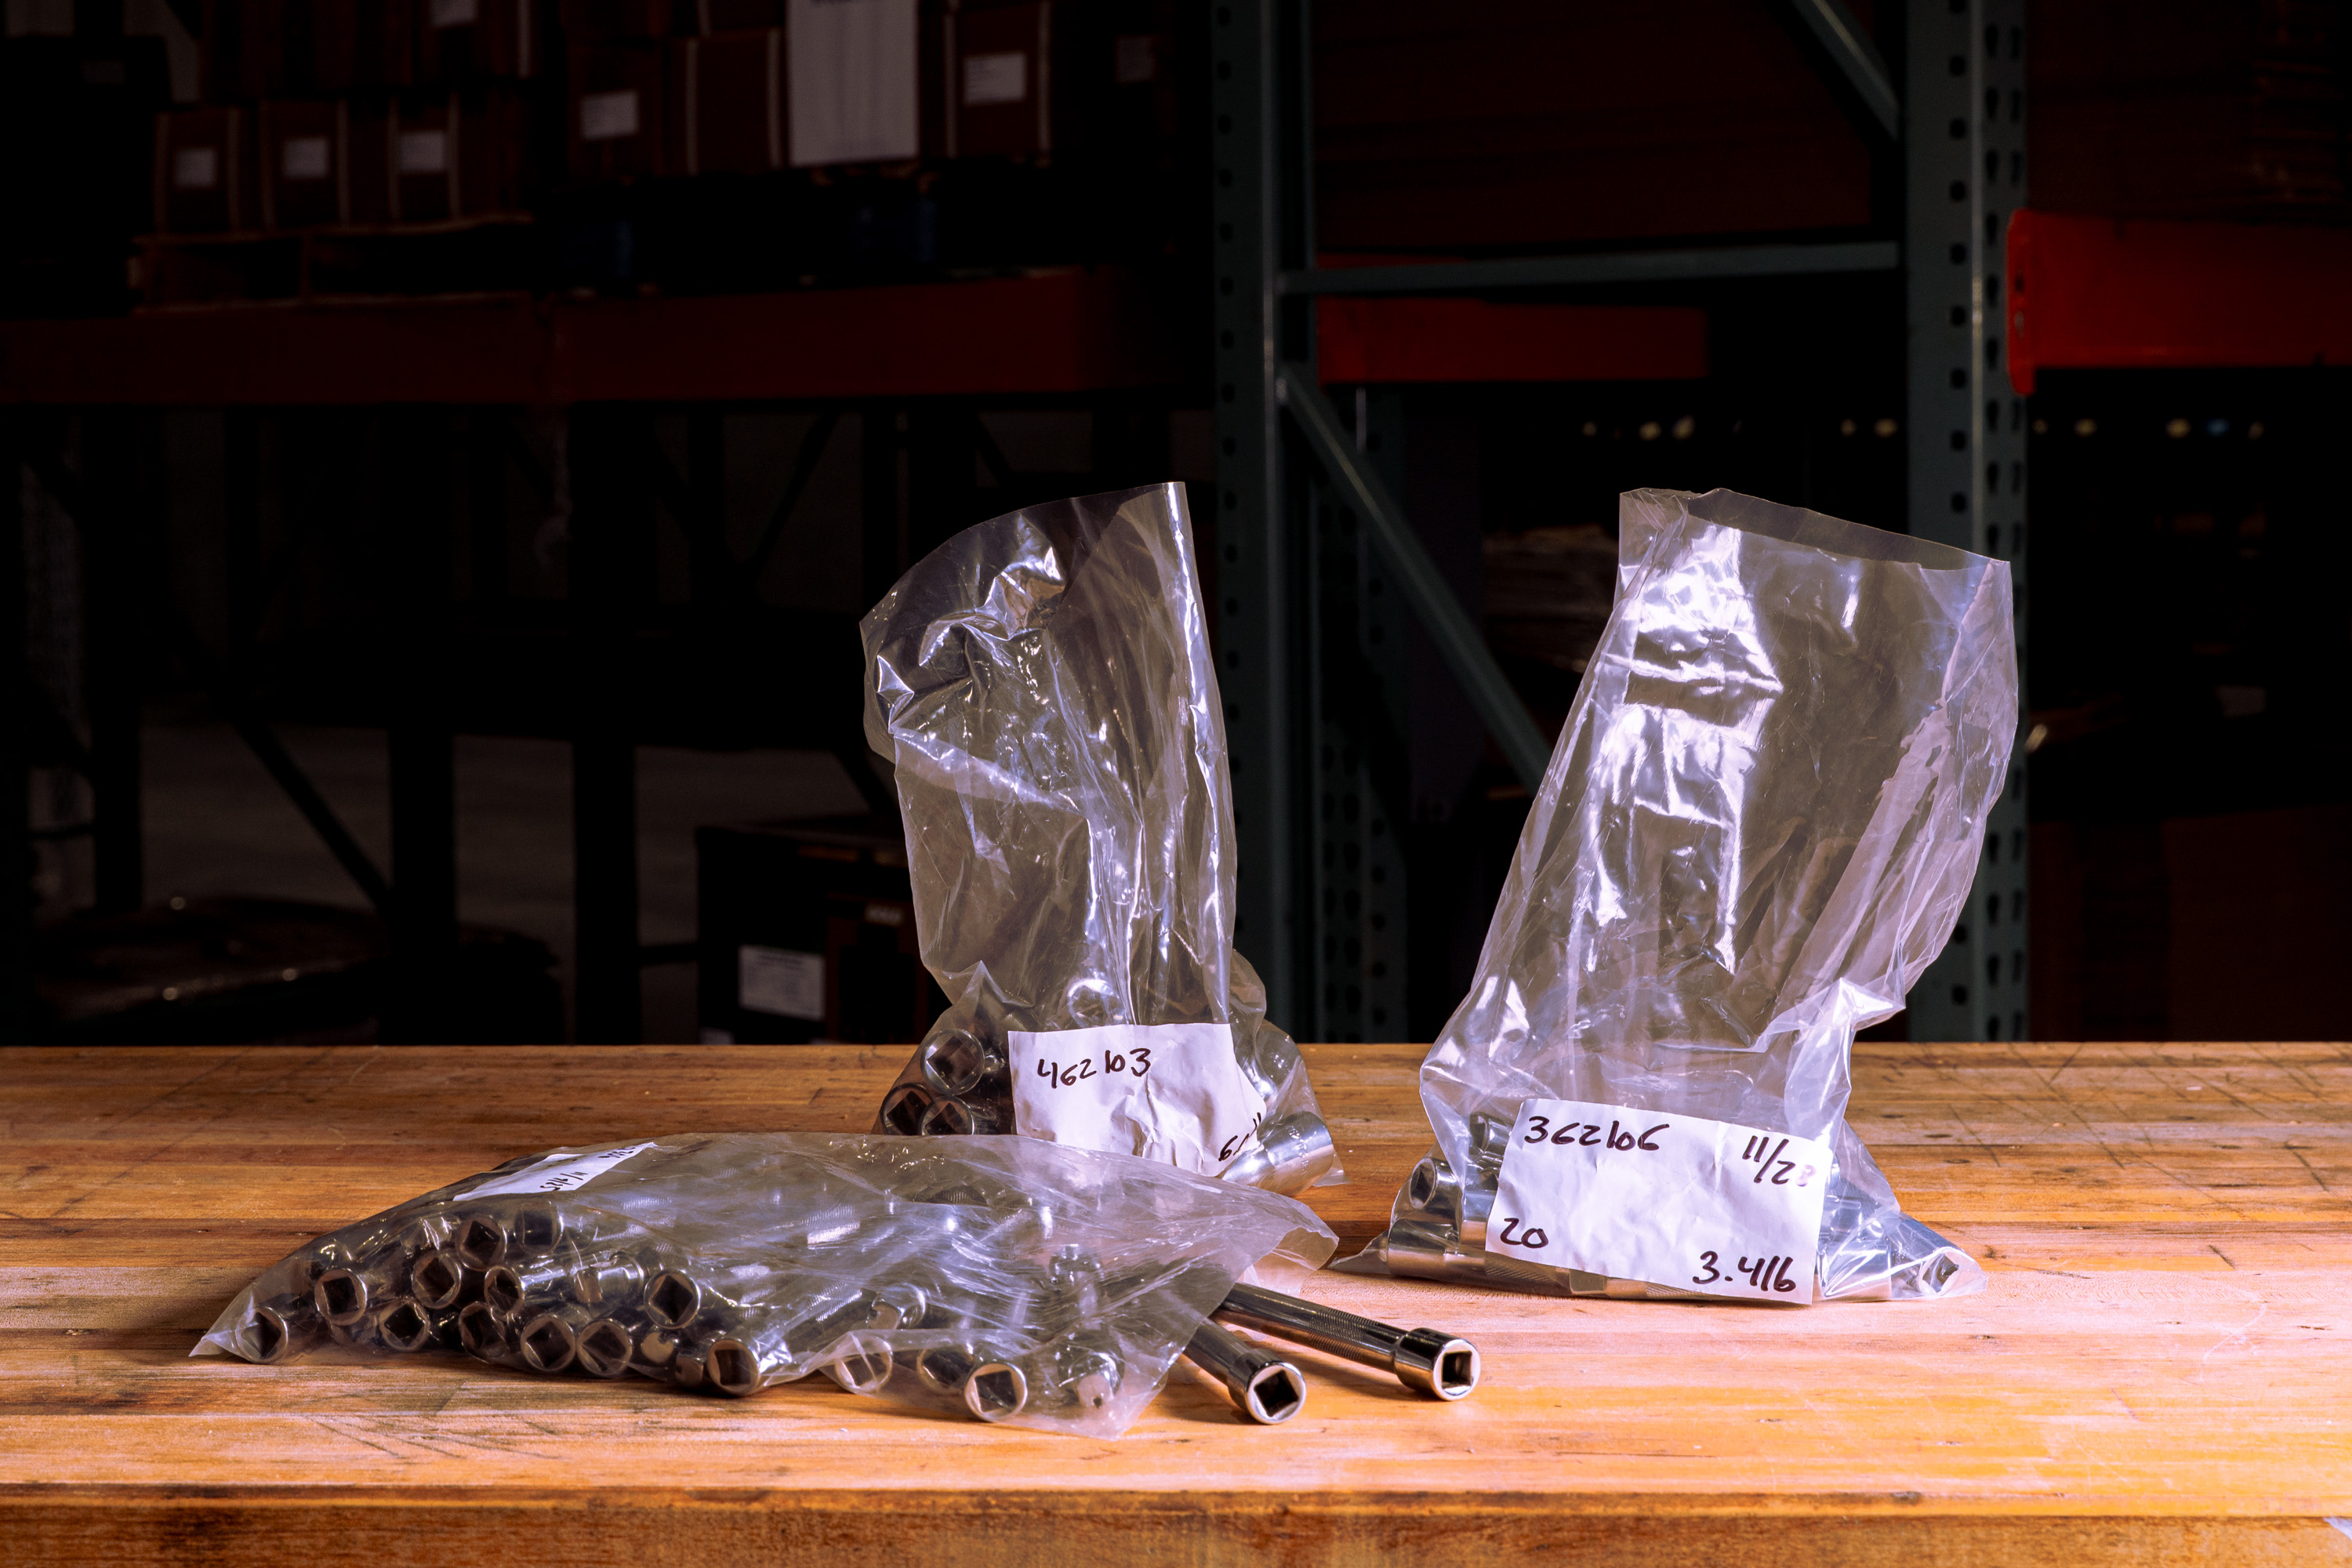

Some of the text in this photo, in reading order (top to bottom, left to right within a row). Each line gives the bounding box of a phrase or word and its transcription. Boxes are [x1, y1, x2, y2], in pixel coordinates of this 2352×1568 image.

[1036, 1047, 1152, 1089] 462103
[1523, 1115, 1670, 1152] 362106
[1499, 1217, 1550, 1249] 20
